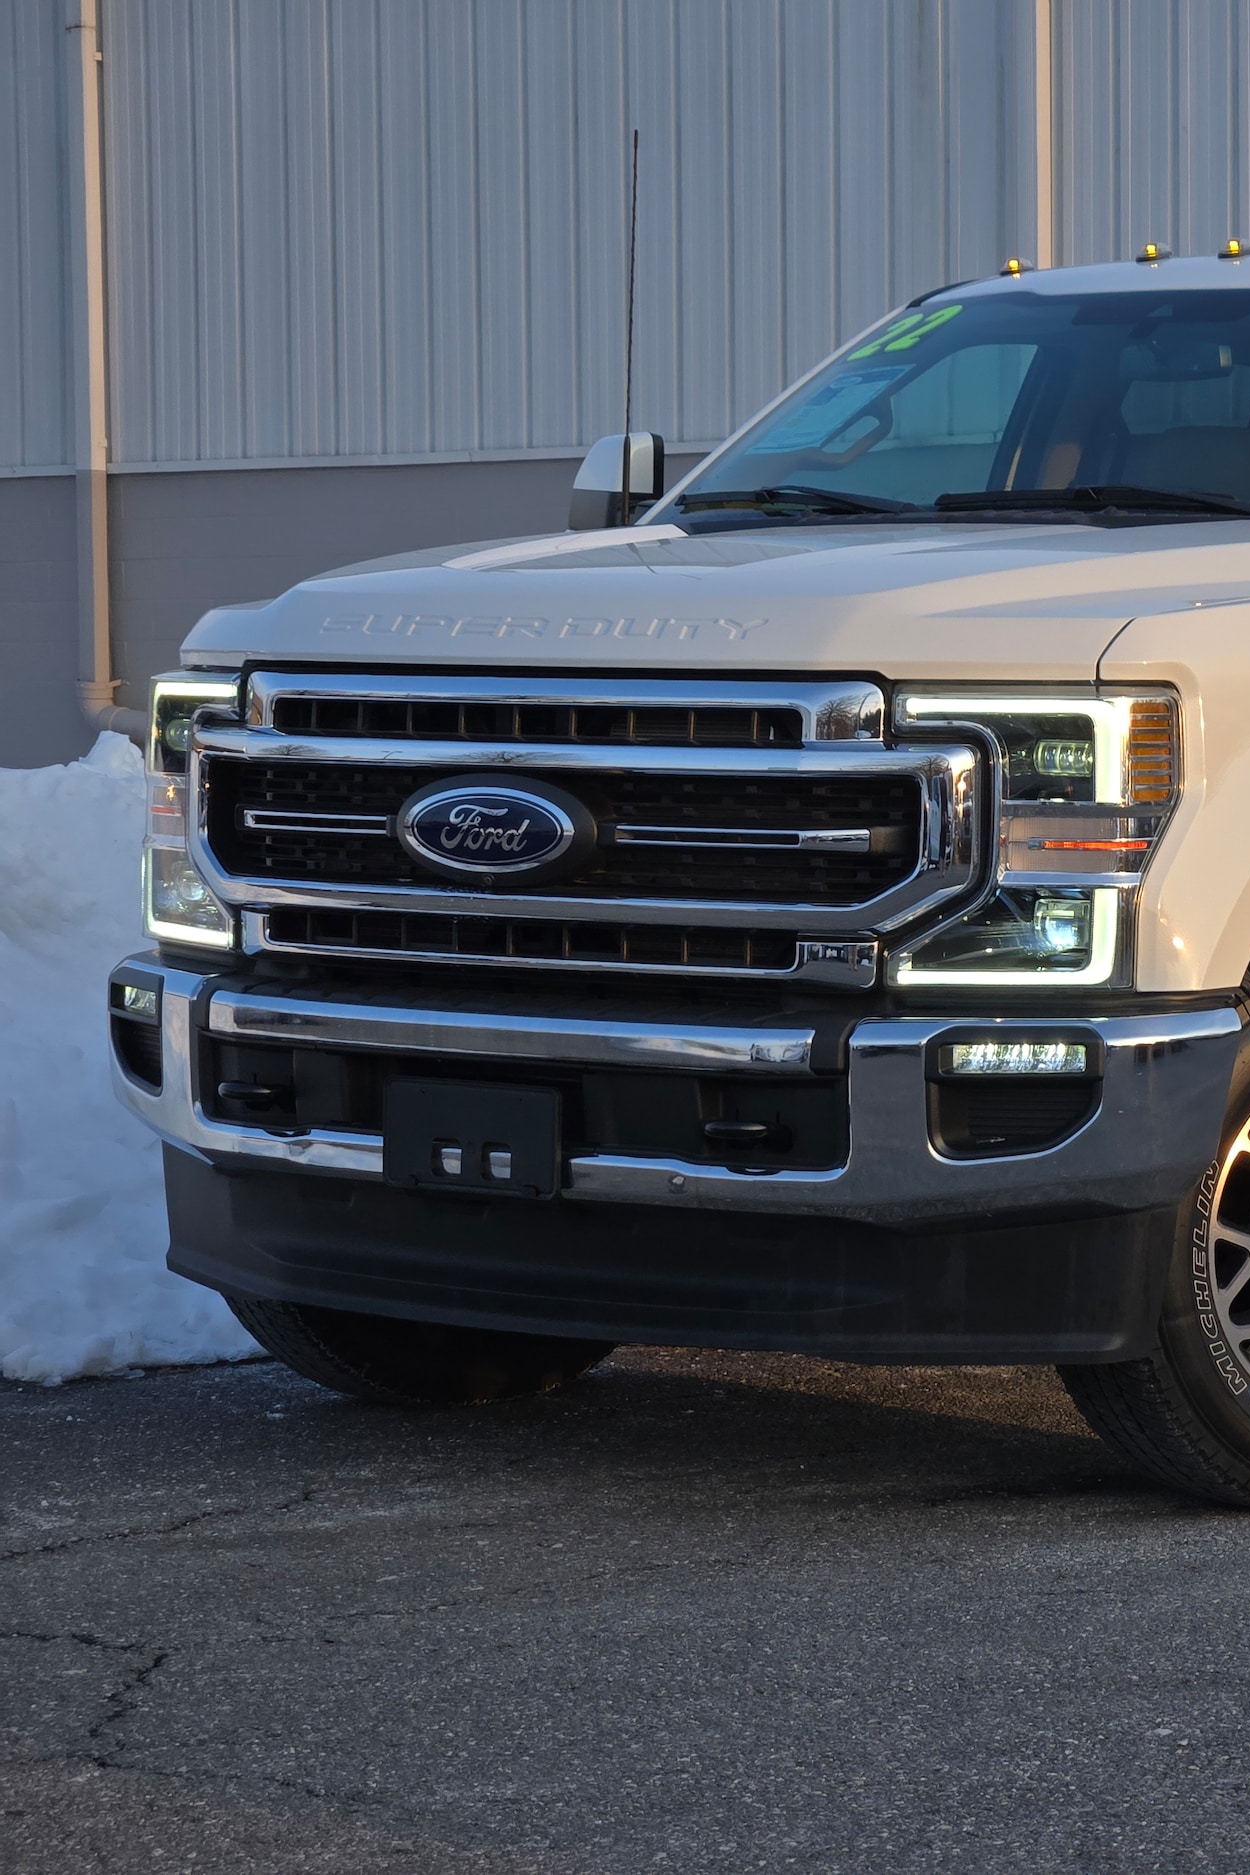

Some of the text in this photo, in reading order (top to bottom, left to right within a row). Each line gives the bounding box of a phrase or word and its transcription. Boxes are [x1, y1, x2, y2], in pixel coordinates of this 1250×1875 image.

[320, 615, 769, 640] SUPER DUTY
[440, 804, 530, 851] Ford
[1191, 1159, 1247, 1396] MICHELIN
